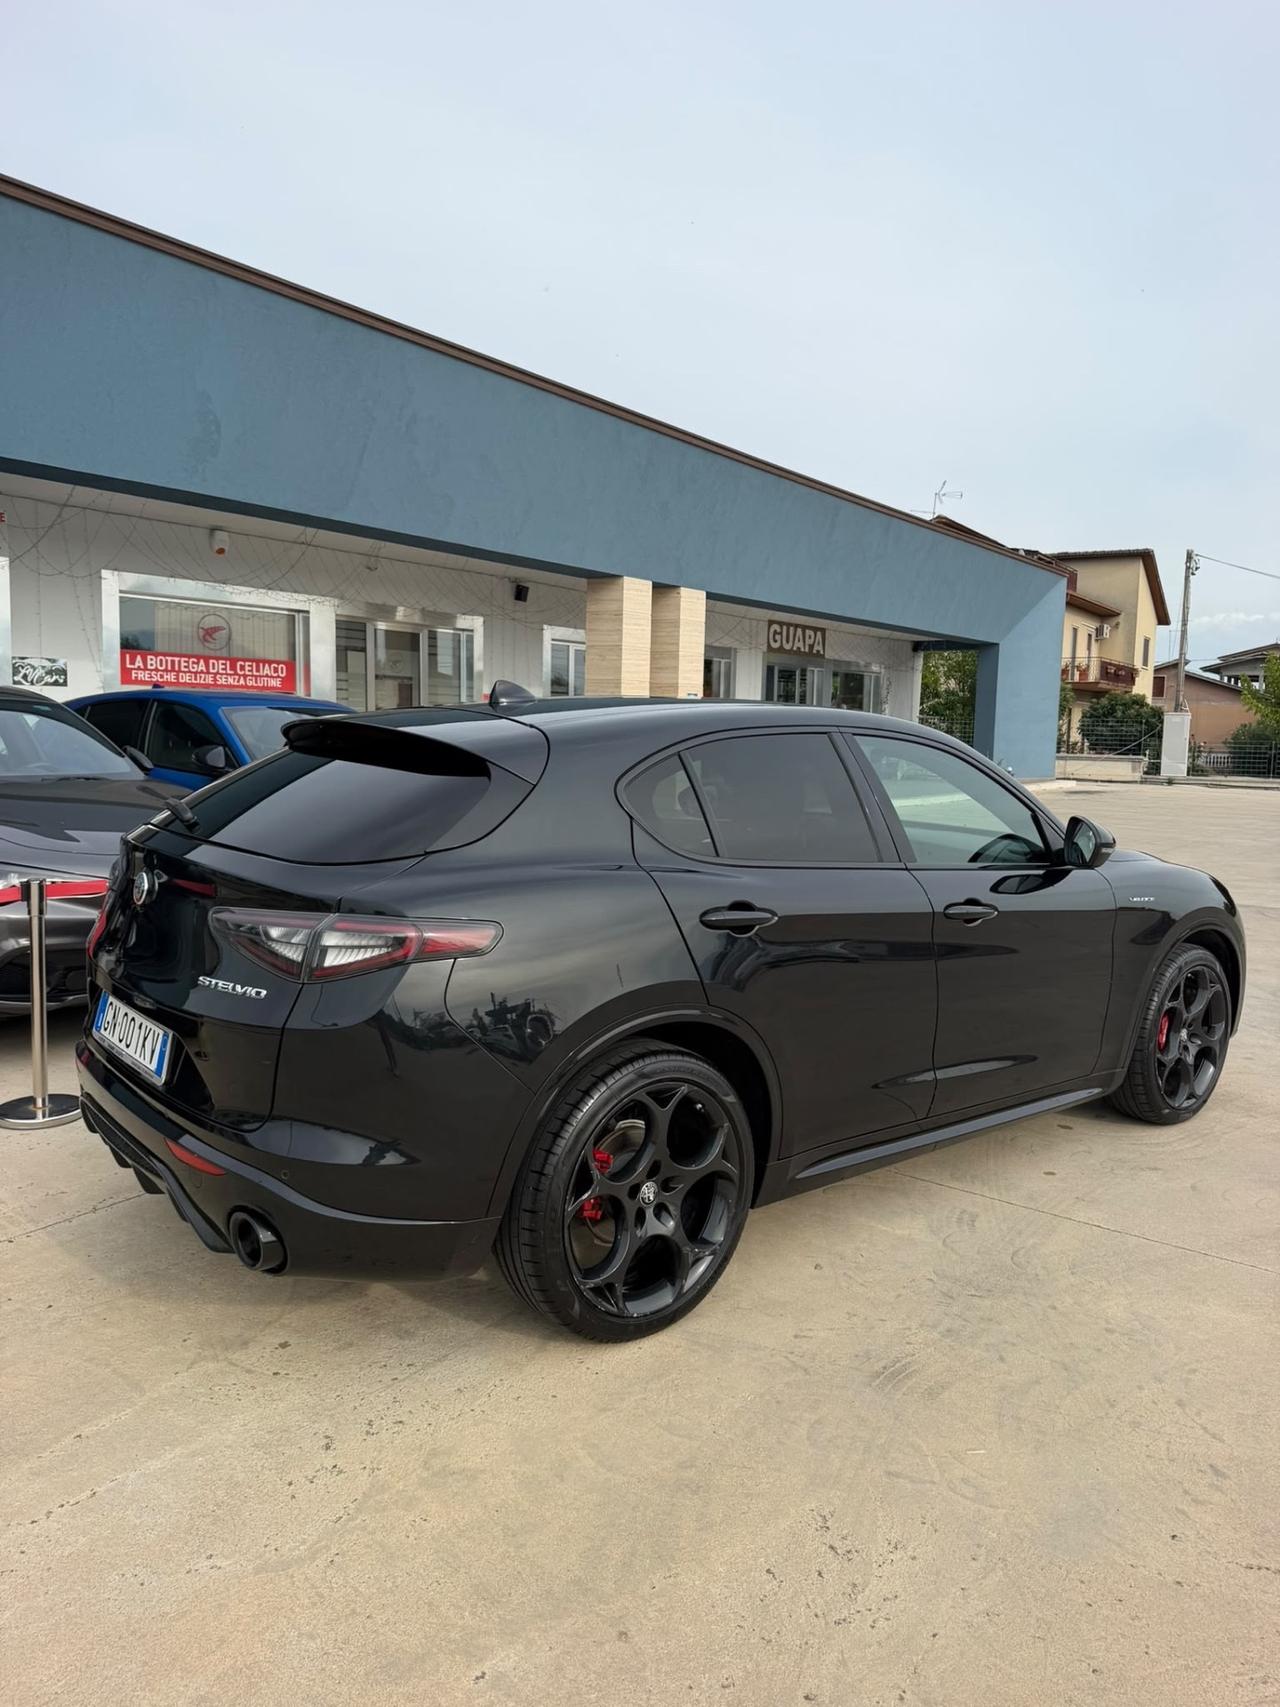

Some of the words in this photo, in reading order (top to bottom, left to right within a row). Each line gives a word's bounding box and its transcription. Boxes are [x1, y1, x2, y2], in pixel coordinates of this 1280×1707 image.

[768, 623, 825, 655] GUAPA
[125, 653, 145, 669] LA
[147, 655, 207, 673] BOTTEGA
[209, 659, 235, 675] DEL
[236, 661, 287, 678] CELIACO
[131, 670, 177, 683] FRESCHE
[179, 672, 215, 685] DELIZIE
[216, 675, 246, 687] SENZA
[246, 677, 283, 688] GLUTINE
[198, 975, 268, 1000] STELVIO
